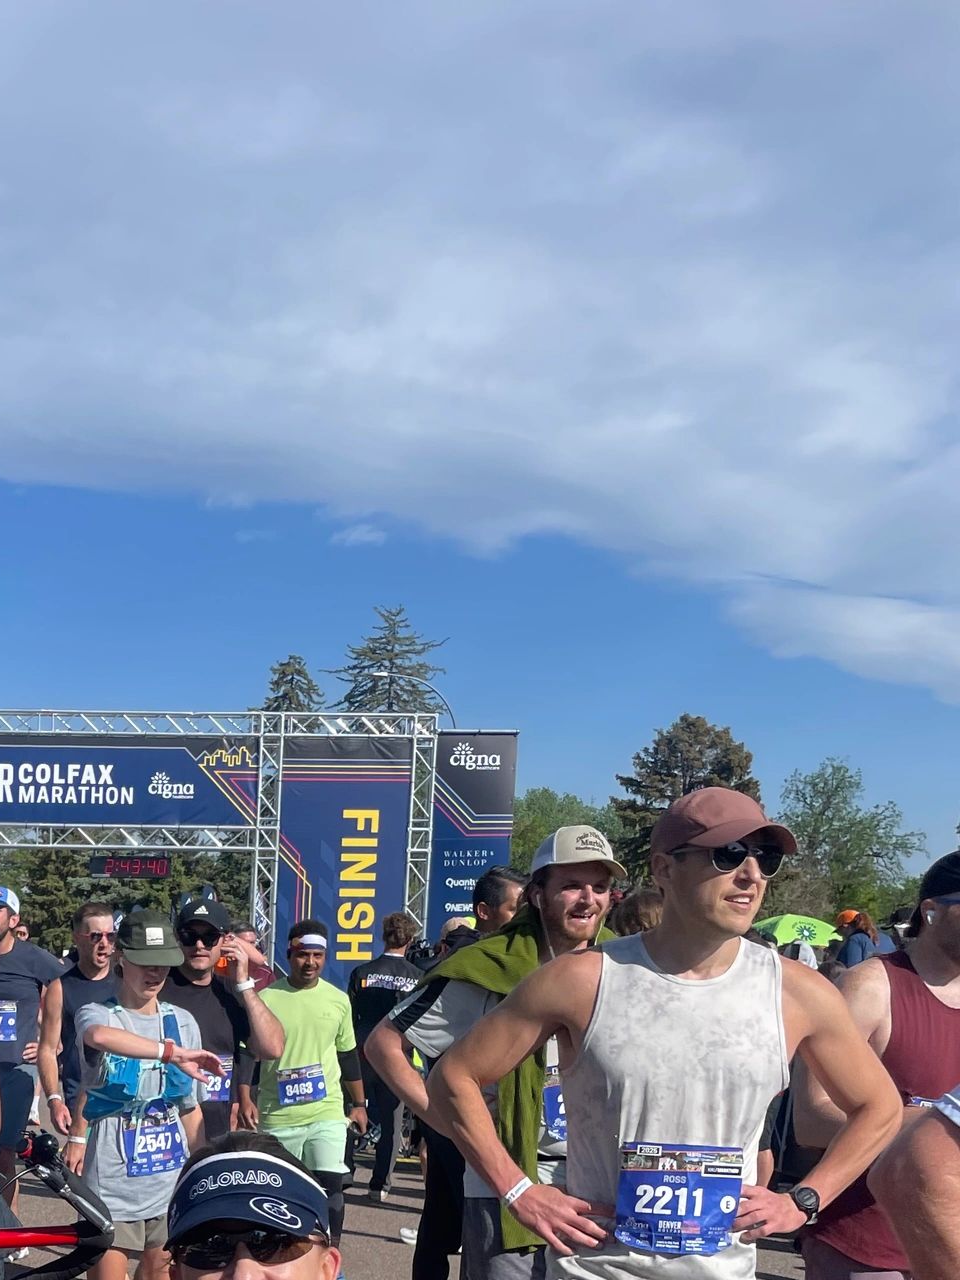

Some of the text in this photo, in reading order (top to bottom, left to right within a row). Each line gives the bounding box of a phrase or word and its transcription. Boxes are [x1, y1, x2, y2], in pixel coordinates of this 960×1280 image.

[450, 750, 501, 771] cigna
[18, 763, 114, 785] COLFAX
[18, 786, 134, 805] MARATHON
[148, 780, 195, 799] cigna
[443, 850, 488, 858] WALKER
[443, 859, 488, 867] DUNLOP
[104, 859, 168, 876] 2:43:40
[336, 809, 380, 960] FINISH
[445, 877, 478, 889] Quantu
[367, 973, 419, 985] DENVER COLFAX
[136, 1132, 172, 1154] 2547
[189, 1170, 283, 1200] COLORADO
[663, 1174, 687, 1184] ROSS
[634, 1184, 704, 1217] 2211
[658, 1220, 682, 1229] DENVER
